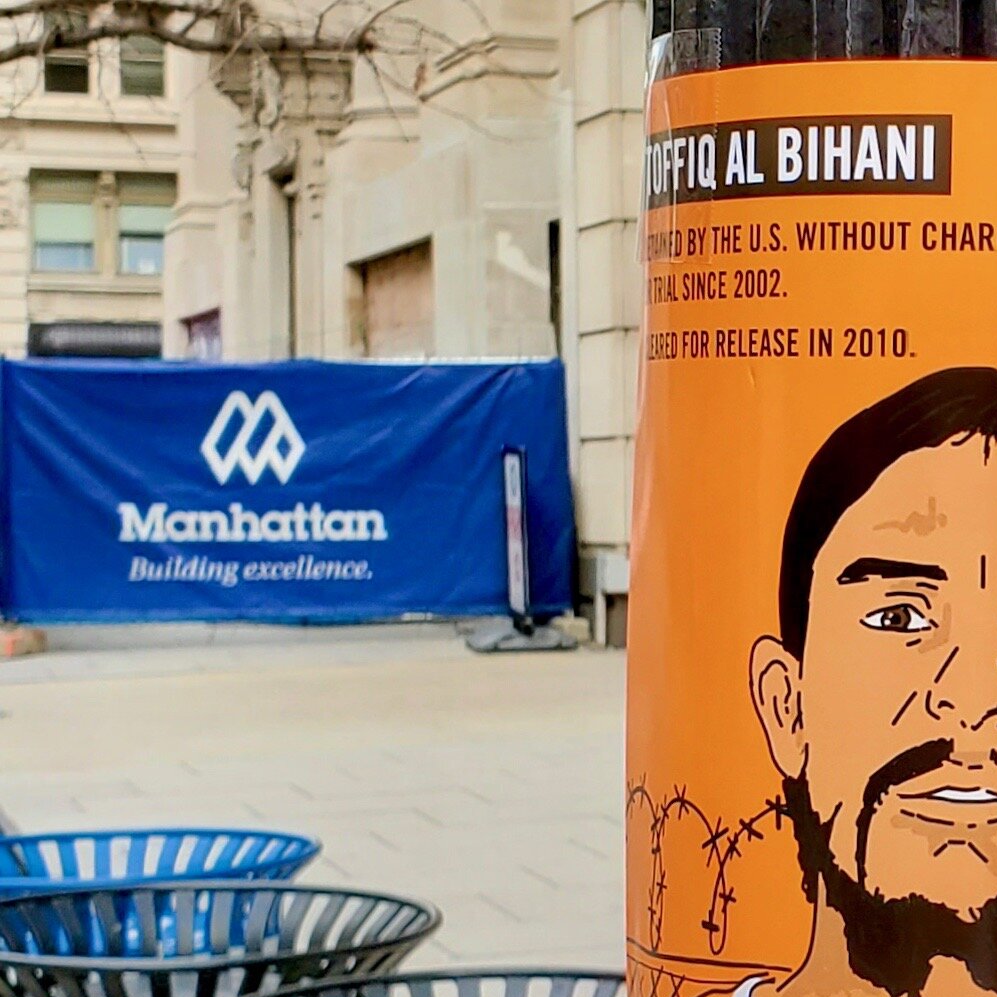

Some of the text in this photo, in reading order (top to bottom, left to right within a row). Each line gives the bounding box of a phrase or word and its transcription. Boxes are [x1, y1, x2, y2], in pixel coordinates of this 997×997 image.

[646, 124, 935, 197] TOFFIQ AL BIHANI
[687, 226, 707, 256] BY
[712, 225, 742, 254] THE
[750, 223, 787, 253] U.S.
[796, 221, 911, 252] WITHOUT
[653, 273, 679, 304] TRIAL
[682, 271, 727, 301] SINCE
[734, 268, 788, 299] 2002.
[682, 330, 709, 359] FOR
[716, 329, 799, 359] RELEASE
[809, 328, 833, 357] IN
[843, 328, 917, 358] 2010.
[118, 502, 388, 543] Manhattan
[128, 556, 373, 587] Building excellence.
